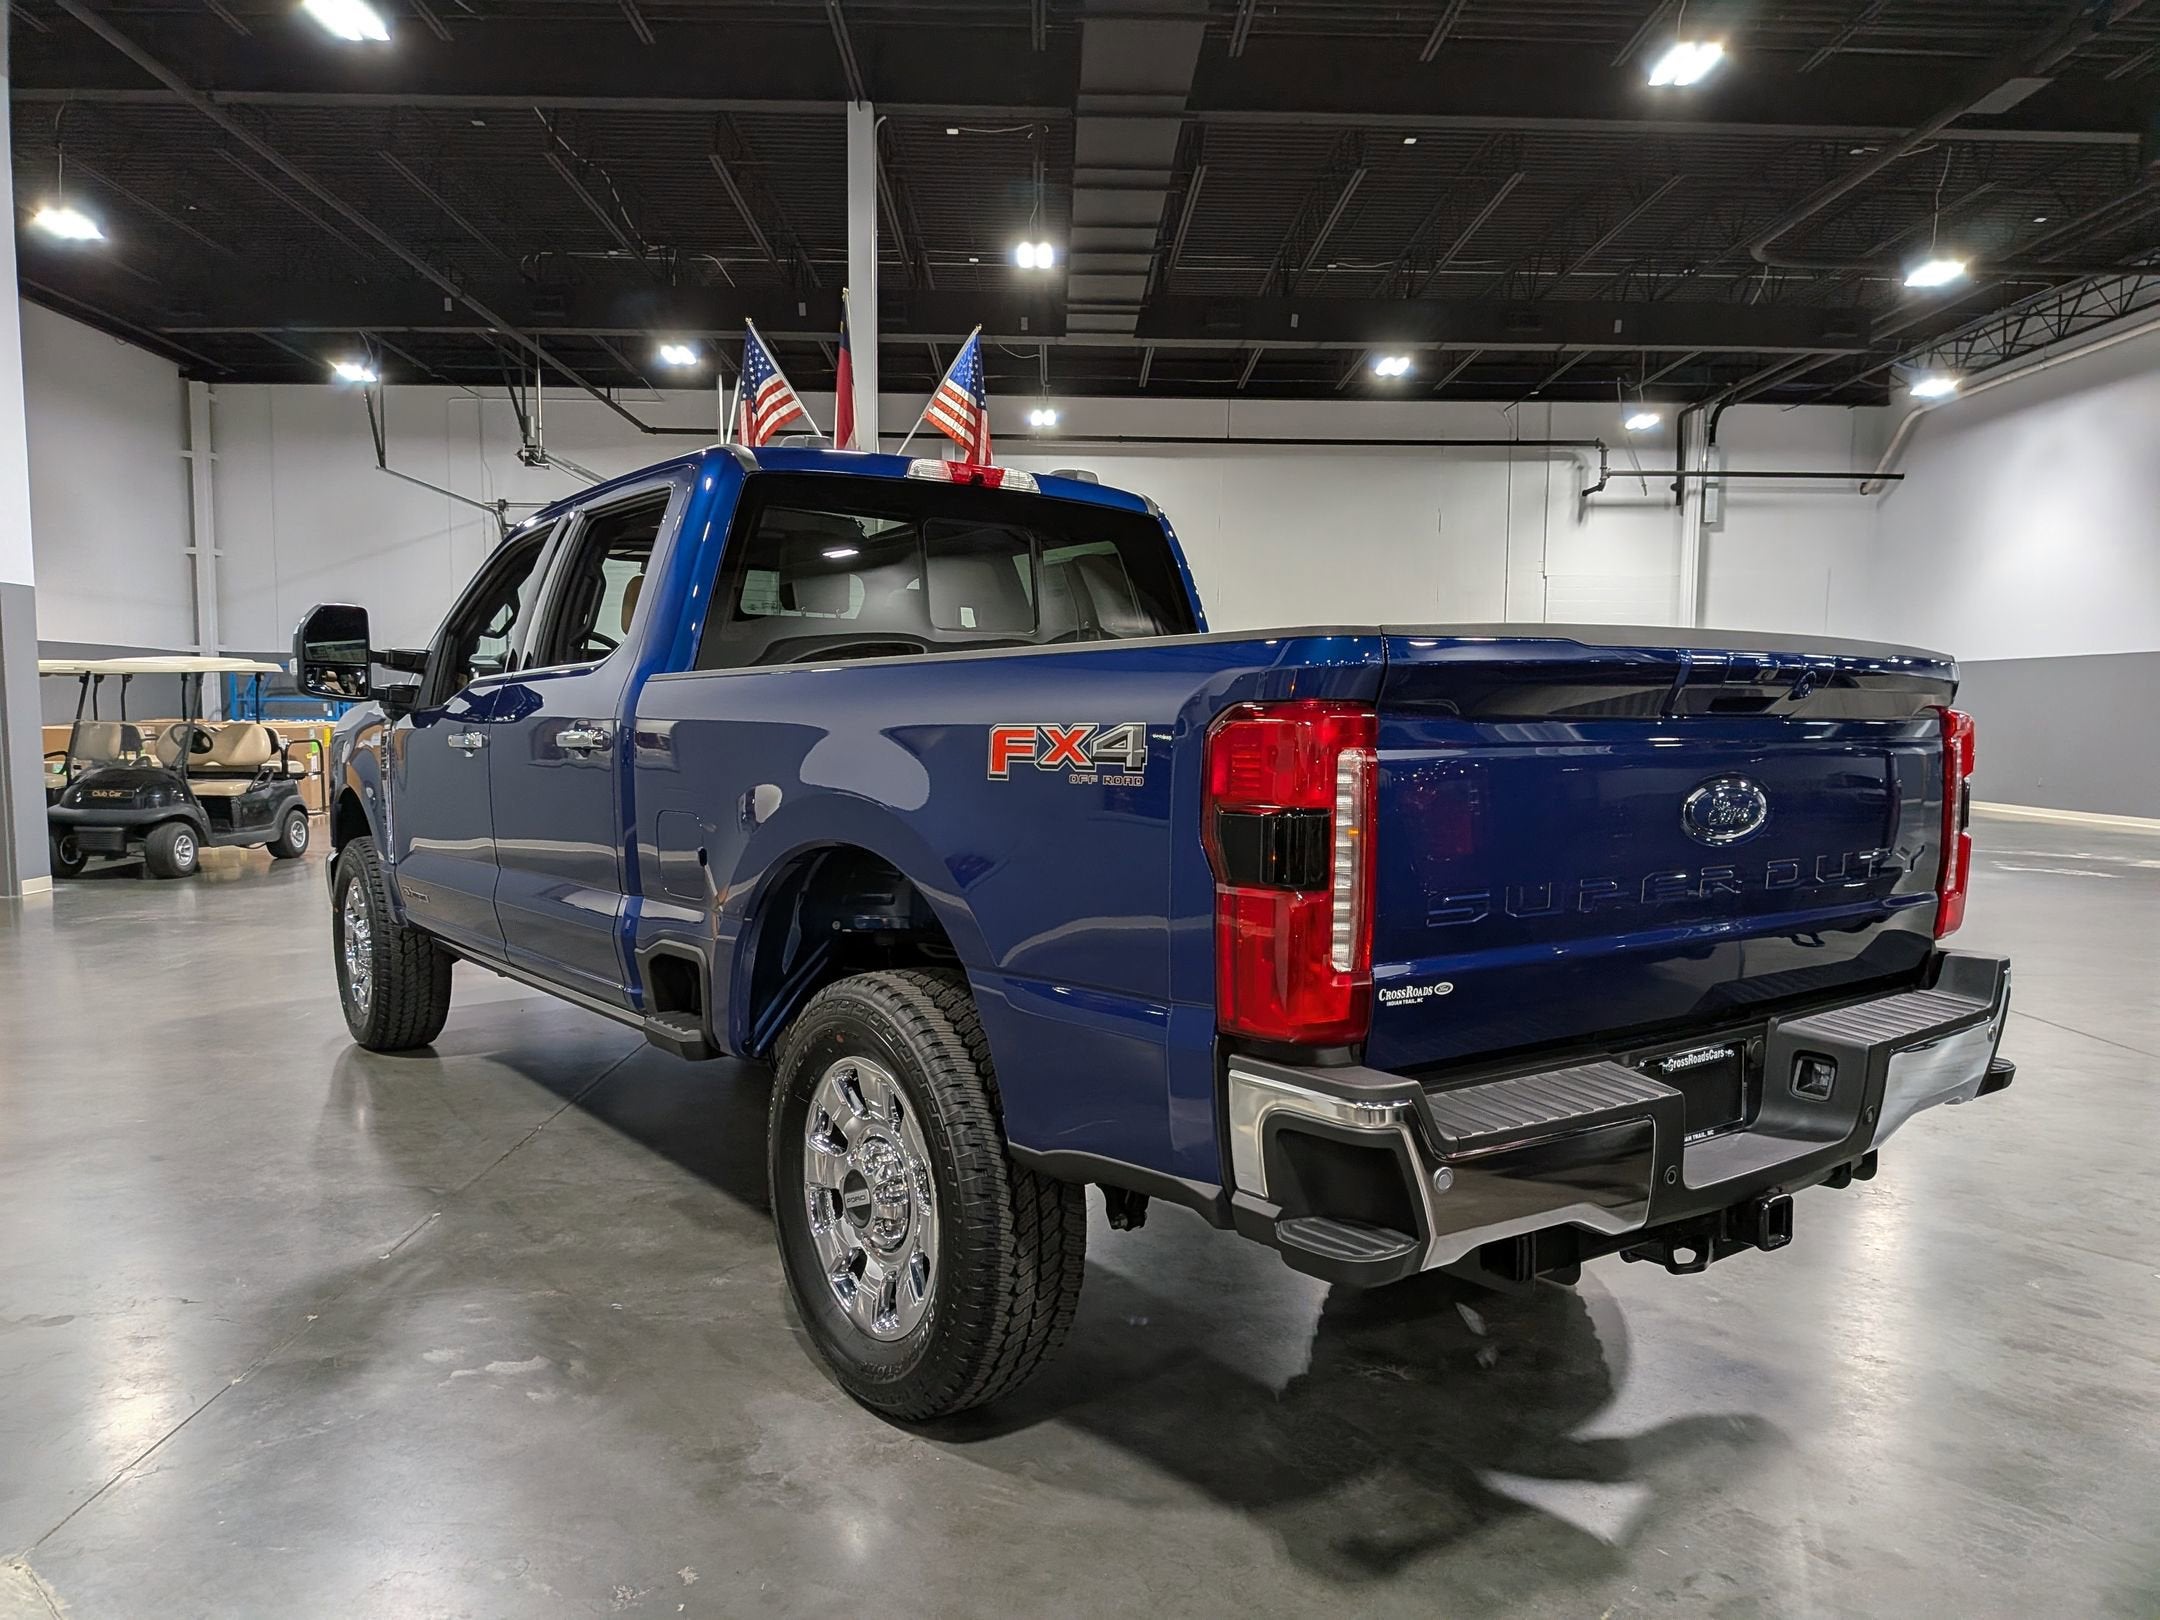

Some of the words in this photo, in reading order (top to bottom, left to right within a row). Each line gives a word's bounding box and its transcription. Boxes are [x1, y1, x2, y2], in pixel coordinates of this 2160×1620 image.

[988, 722, 1148, 780] FX4
[1069, 774, 1098, 784] OFF
[1103, 775, 1144, 787] ROAD
[1427, 864, 1743, 928] SUPER
[1766, 844, 1926, 890] DUTY
